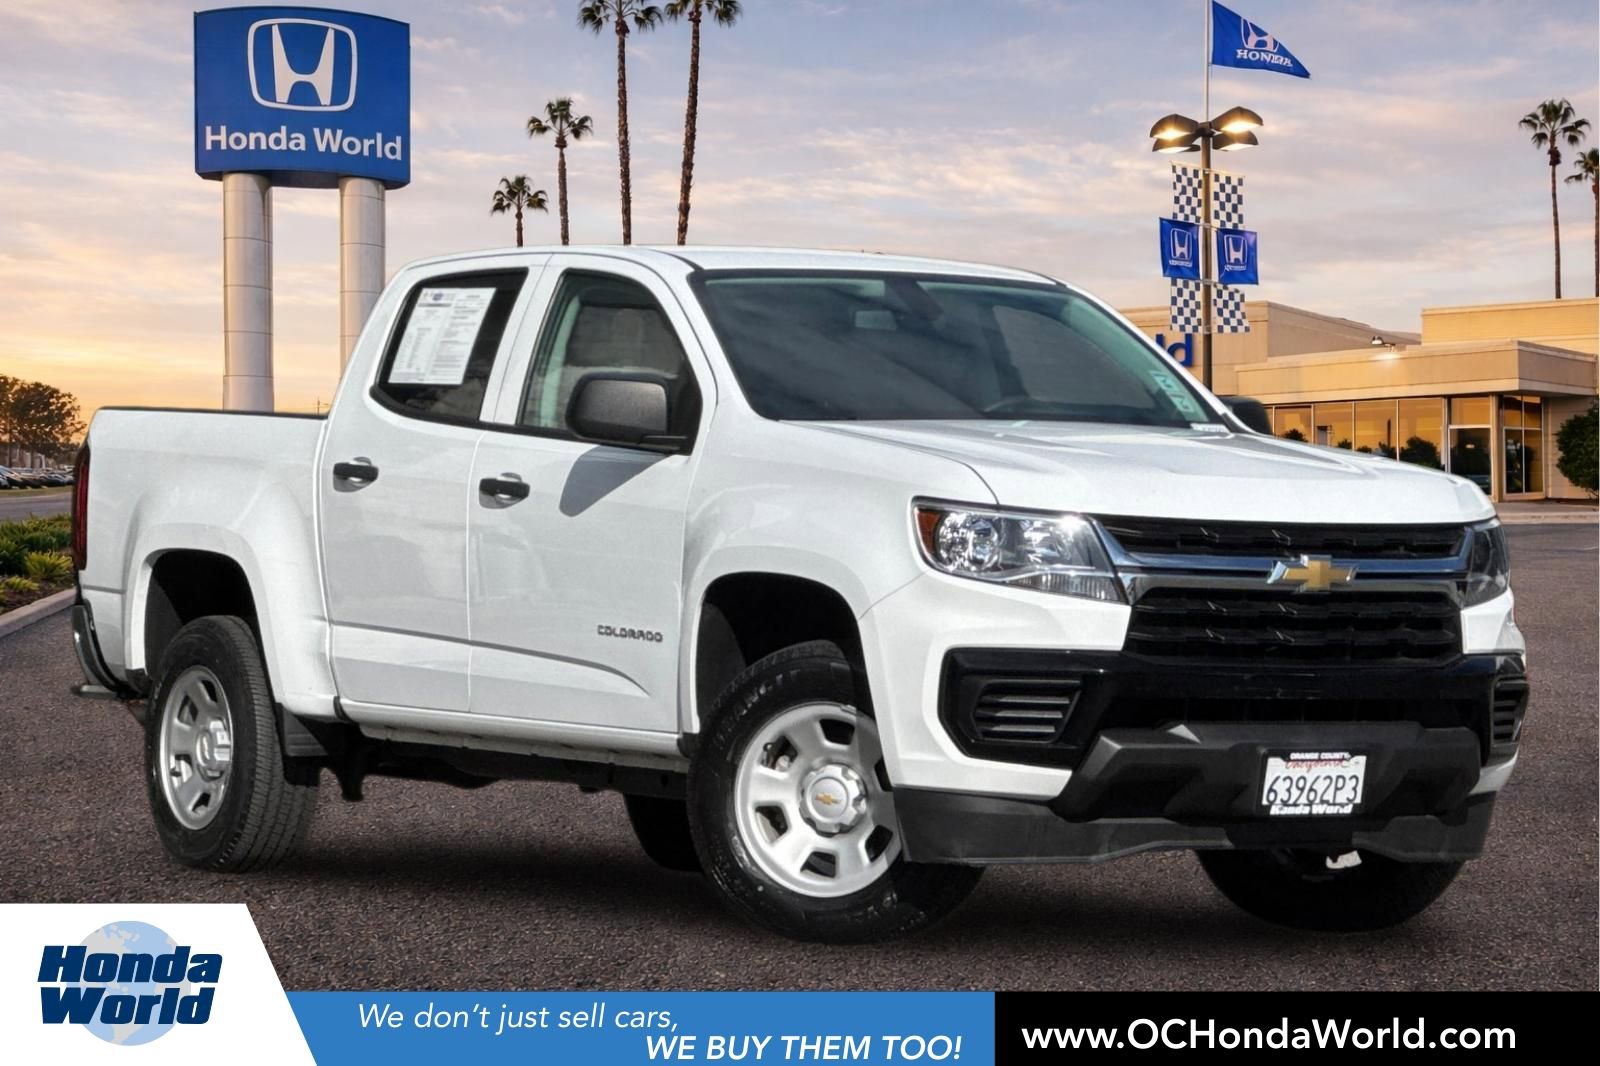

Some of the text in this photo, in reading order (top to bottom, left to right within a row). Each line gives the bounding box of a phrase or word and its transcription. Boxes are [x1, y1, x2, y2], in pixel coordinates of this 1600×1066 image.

[1236, 49, 1293, 67] HONDA
[205, 125, 402, 161] Honda World
[597, 624, 663, 642] COLORADO
[1265, 775, 1359, 804] 63962P3
